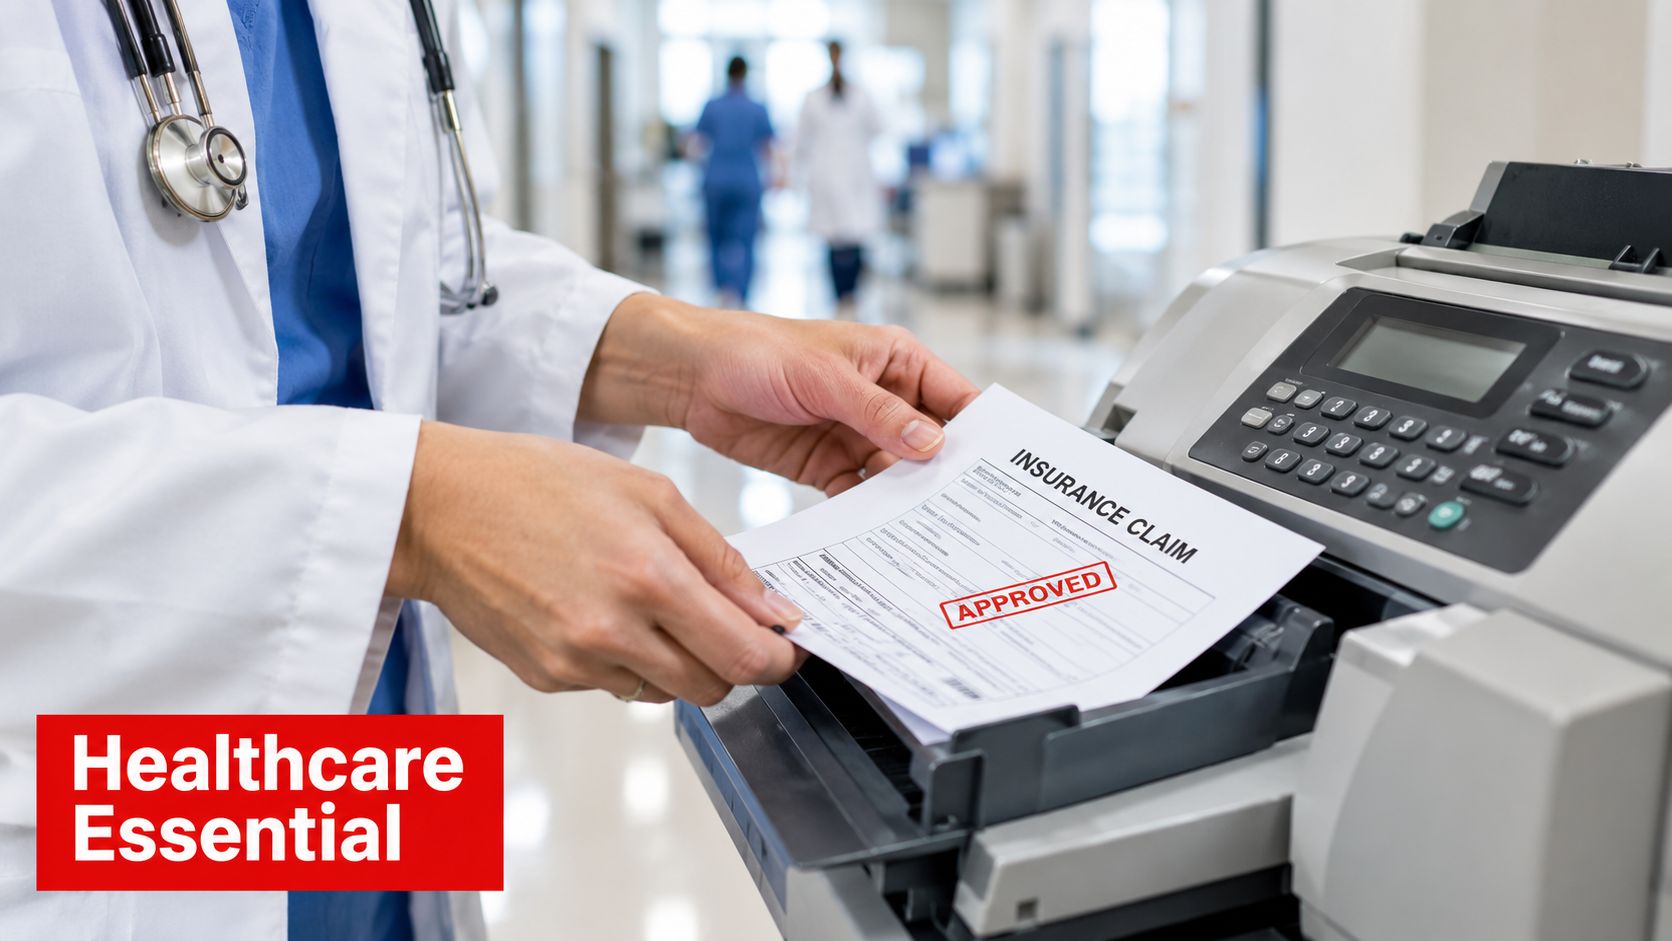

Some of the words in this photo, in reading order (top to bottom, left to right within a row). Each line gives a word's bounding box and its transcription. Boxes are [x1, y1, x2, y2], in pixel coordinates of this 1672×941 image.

[1010, 448, 1131, 526] INSURANCE
[1126, 518, 1198, 564] CLAIM
[958, 571, 1102, 622] APPROVED
